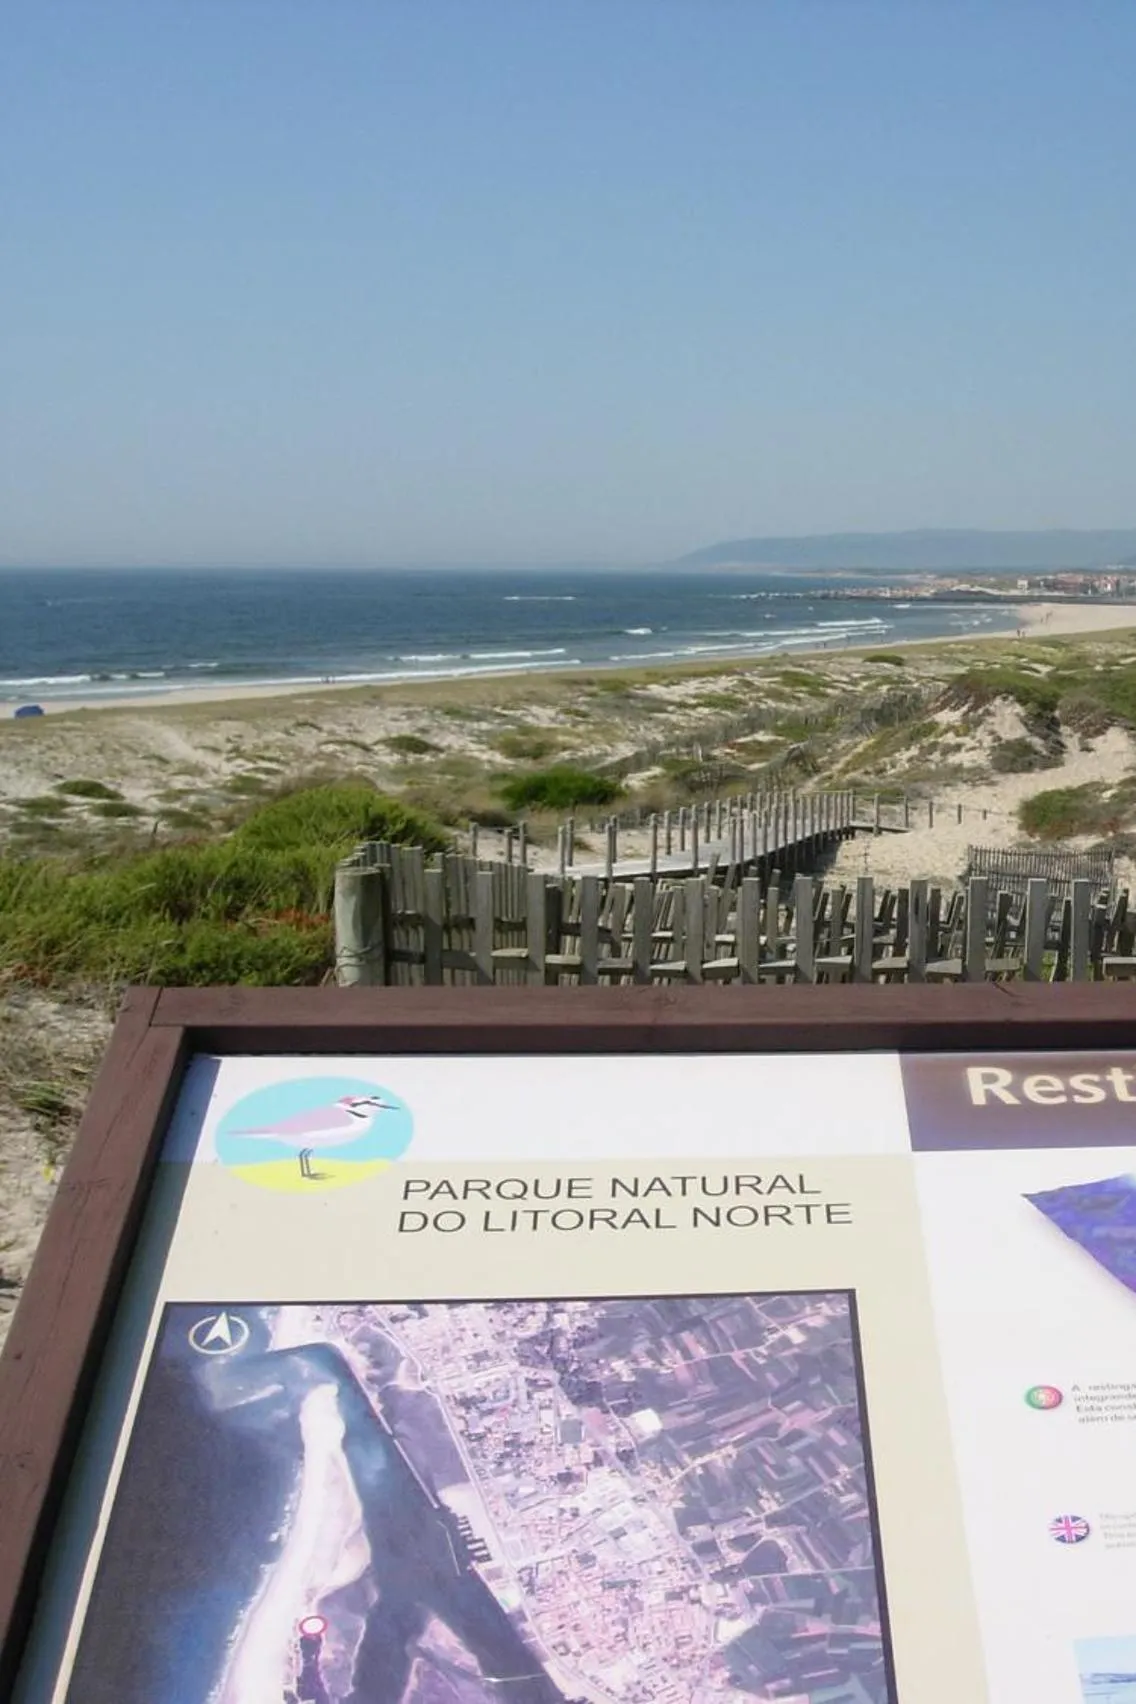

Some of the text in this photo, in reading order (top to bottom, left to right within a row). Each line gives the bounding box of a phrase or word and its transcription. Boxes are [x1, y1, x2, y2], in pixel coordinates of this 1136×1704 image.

[402, 1173, 822, 1200] PARQUE NATURAL
[398, 1203, 854, 1233] DO LITORAL NORTE
